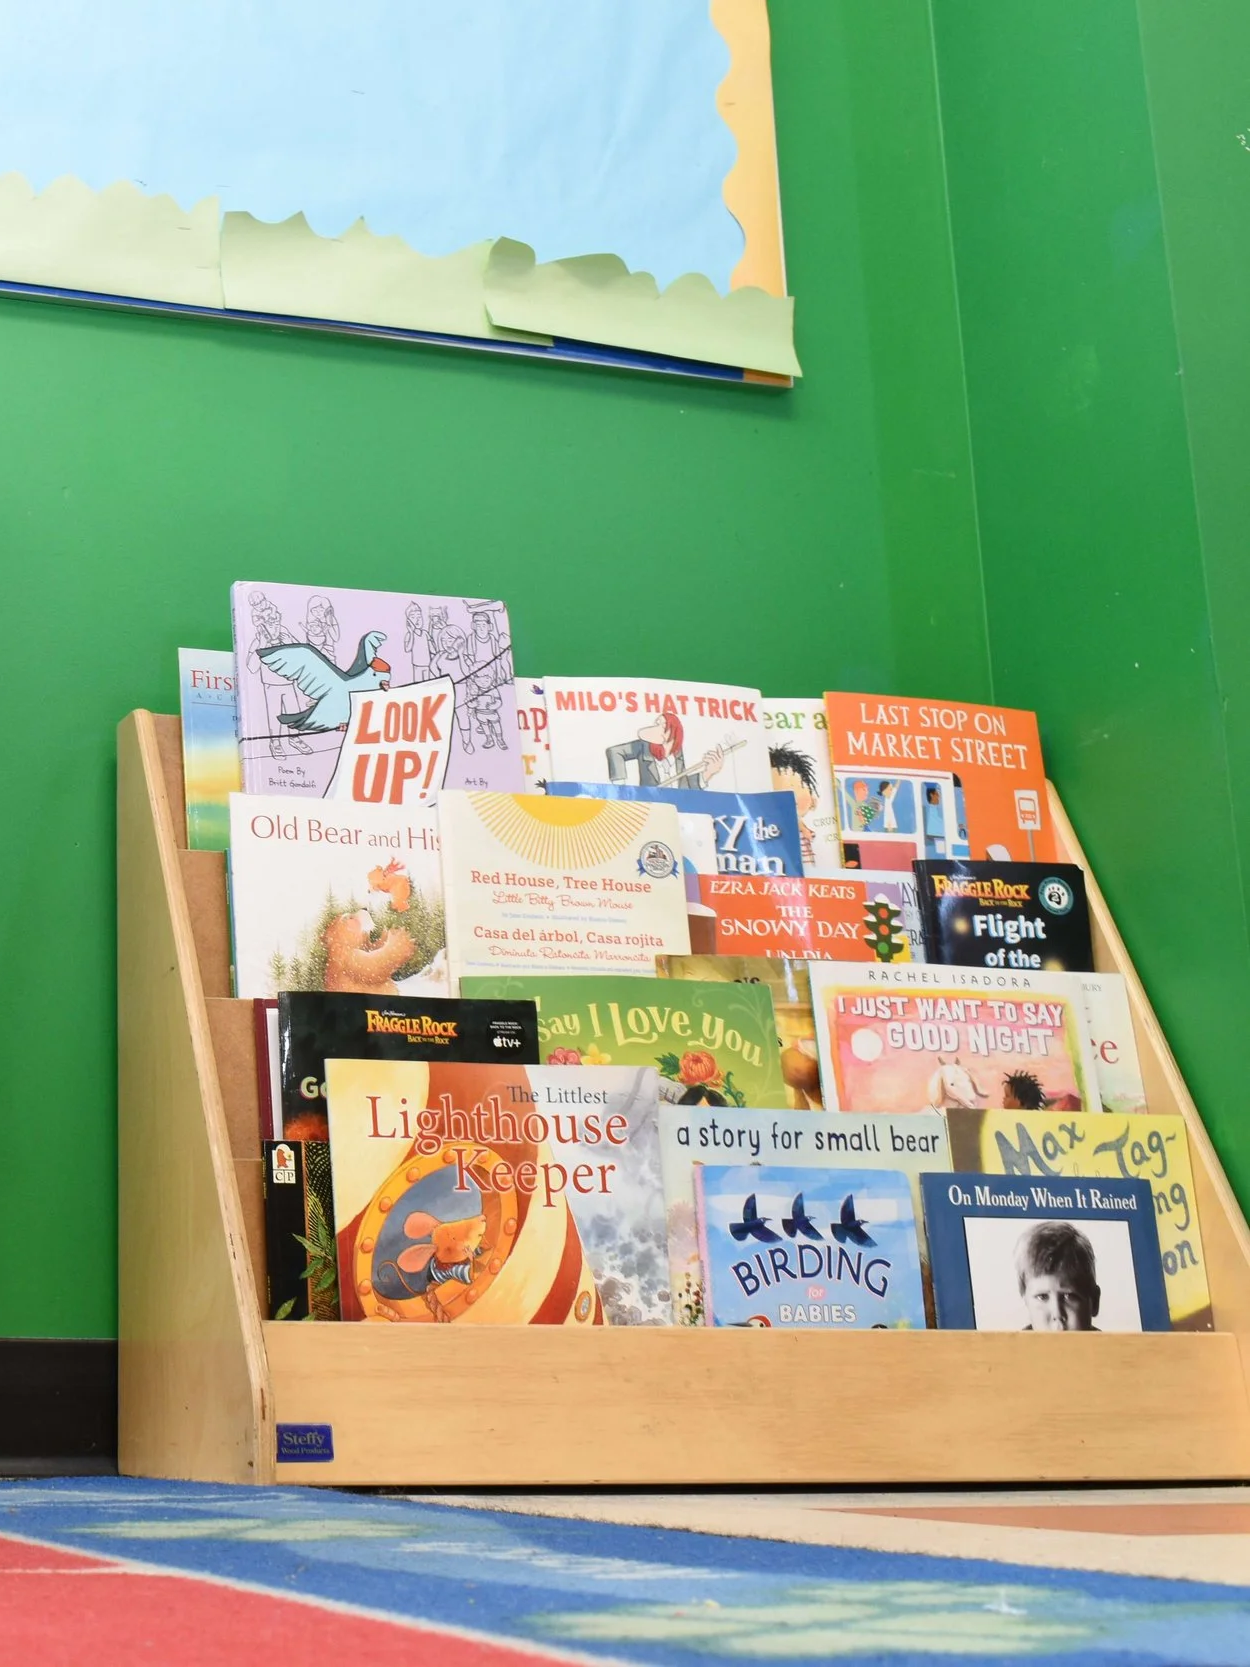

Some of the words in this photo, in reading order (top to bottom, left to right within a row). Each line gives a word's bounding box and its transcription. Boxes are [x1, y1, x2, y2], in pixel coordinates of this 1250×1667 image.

[190, 668, 237, 692] Firs
[555, 689, 639, 714] MILO'S
[645, 693, 690, 716] HAT
[693, 696, 759, 723] TRICK
[354, 692, 448, 745] LOOK
[859, 702, 910, 728] LAST
[918, 706, 968, 731] STOP
[974, 712, 1007, 737] ON
[847, 731, 942, 760] MARKET
[950, 736, 1028, 770] STREET
[268, 777, 287, 787] Britt
[277, 766, 295, 774] Poem
[296, 766, 306, 777] By
[351, 750, 439, 806] UP!
[464, 777, 477, 786] Art
[478, 778, 488, 787] By
[250, 813, 297, 841] Old
[307, 818, 363, 847] Bear
[368, 829, 401, 849] and
[752, 816, 780, 841] the
[470, 870, 501, 885] Red
[504, 873, 559, 890] House,
[563, 876, 598, 890] Tree
[602, 878, 652, 893] House
[709, 879, 756, 897] EZRA
[758, 880, 805, 898] JACK
[808, 883, 857, 900] KEATS
[931, 874, 992, 899] FRAGGLE
[991, 878, 1031, 901] ROCK
[492, 890, 524, 904] Little
[525, 892, 555, 912] Bitty
[556, 894, 596, 909] Brown
[598, 897, 634, 910] Mouse
[776, 904, 814, 919] THE
[473, 926, 509, 940] Casa
[512, 927, 535, 941] del
[538, 929, 584, 944] árbol,
[586, 931, 621, 945] Casa
[625, 933, 664, 949] rojita
[719, 917, 807, 939] SNOWY
[816, 920, 865, 941] DAY
[972, 913, 1047, 945] Flight
[489, 945, 538, 958] Diminuta
[984, 947, 1006, 967] of
[1007, 949, 1042, 969] the
[868, 969, 941, 984] RACHEL
[951, 972, 1033, 988] ISADORA
[365, 1009, 421, 1035] FRAGGLE
[420, 1015, 459, 1038] ROCK
[587, 1003, 603, 1038] I
[837, 996, 846, 1015] I
[850, 996, 911, 1021] JUST
[914, 997, 982, 1023] WANT
[987, 1000, 1017, 1023] TO
[1021, 1002, 1063, 1029] SAY
[407, 1034, 423, 1043] BACK
[434, 1036, 450, 1045] ROCK
[502, 1036, 522, 1048] tv+
[885, 1021, 961, 1053] GOOD
[969, 1025, 1054, 1057] NIGHT
[506, 1085, 540, 1105] The
[545, 1085, 610, 1105] Littlest
[366, 1094, 629, 1157] Lighthouse
[676, 1125, 691, 1146] a
[699, 1123, 761, 1157] story
[771, 1127, 804, 1150] for
[813, 1124, 883, 1153] small
[890, 1131, 940, 1155] bear
[995, 1120, 1086, 1177] Max
[455, 1147, 617, 1208] Keeper
[948, 1184, 971, 1206] On
[975, 1185, 1029, 1212] Monday
[1032, 1187, 1073, 1209] When
[1075, 1190, 1088, 1209] It
[1091, 1191, 1138, 1211] Rained
[731, 1243, 893, 1299] BIRDING
[806, 1285, 825, 1300] for
[778, 1304, 858, 1324] BABIES
[282, 1430, 326, 1447] Steffy
[280, 1447, 300, 1455] Wood
[301, 1447, 331, 1455] Products
